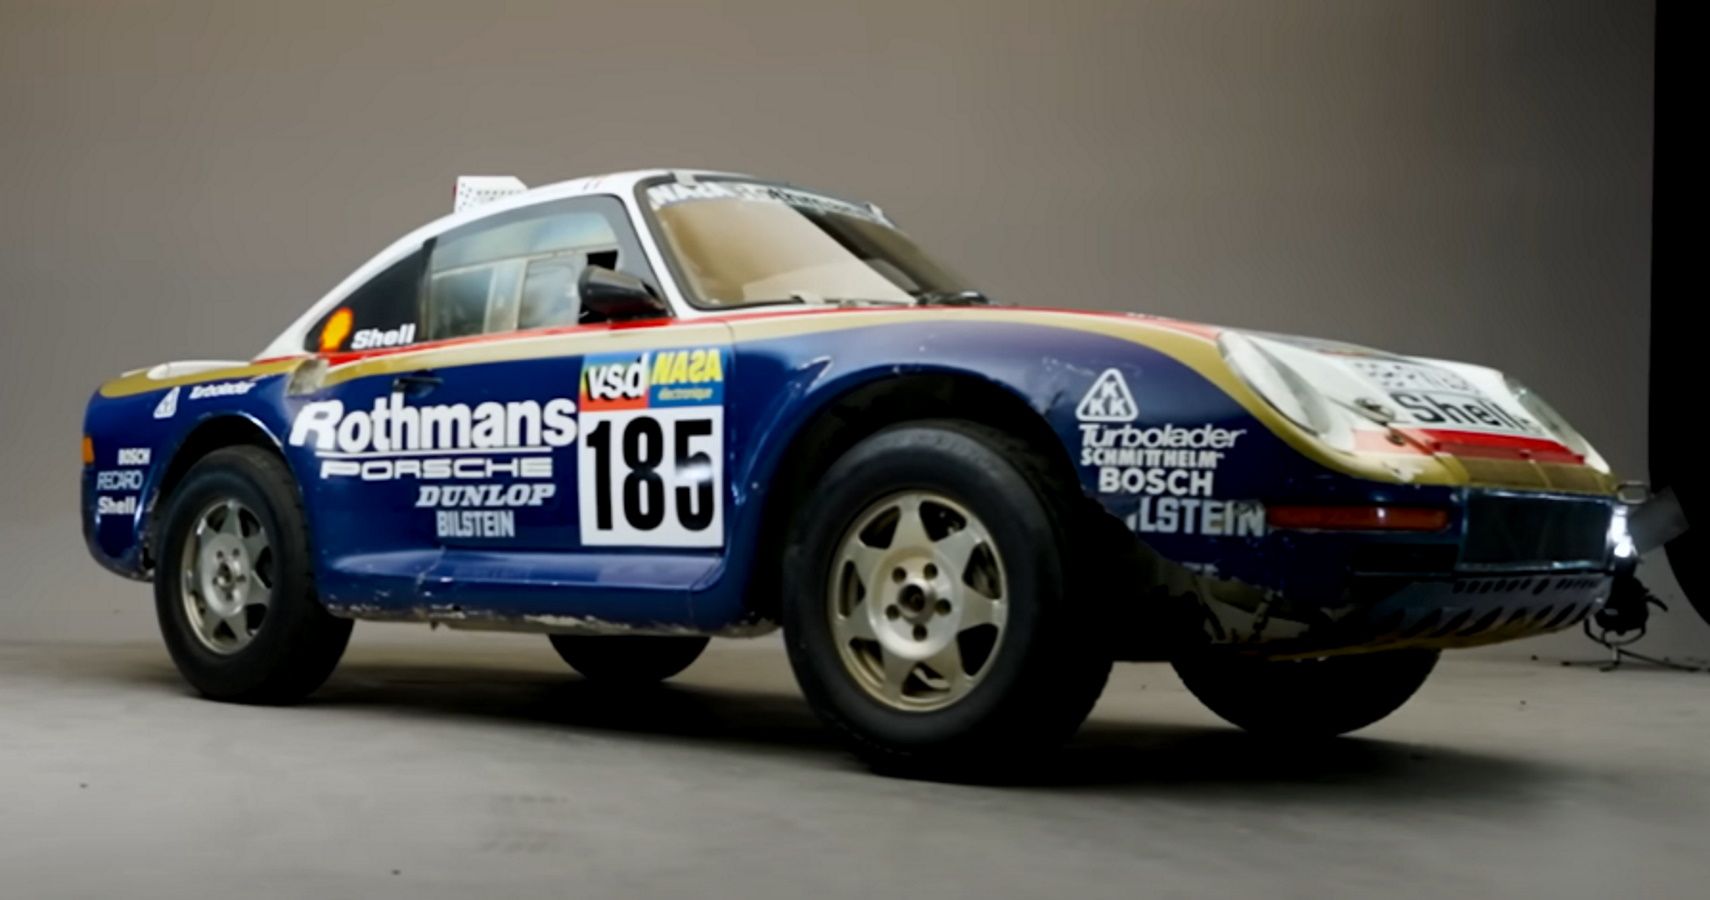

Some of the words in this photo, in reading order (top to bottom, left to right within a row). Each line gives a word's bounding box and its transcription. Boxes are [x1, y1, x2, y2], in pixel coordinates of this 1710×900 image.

[351, 323, 416, 350] Shell
[585, 353, 650, 402] vsd
[289, 391, 578, 453] Rothmans
[1389, 393, 1526, 431] Shell
[1079, 424, 1247, 448] Turbolader
[97, 470, 143, 490] RECARO
[320, 457, 553, 480] PORSCHE
[586, 416, 715, 532] 185
[1098, 467, 1213, 496] BOSCH
[98, 496, 137, 515] Shell
[415, 483, 556, 507] DUNLOP
[436, 510, 515, 537] BILSTEIN
